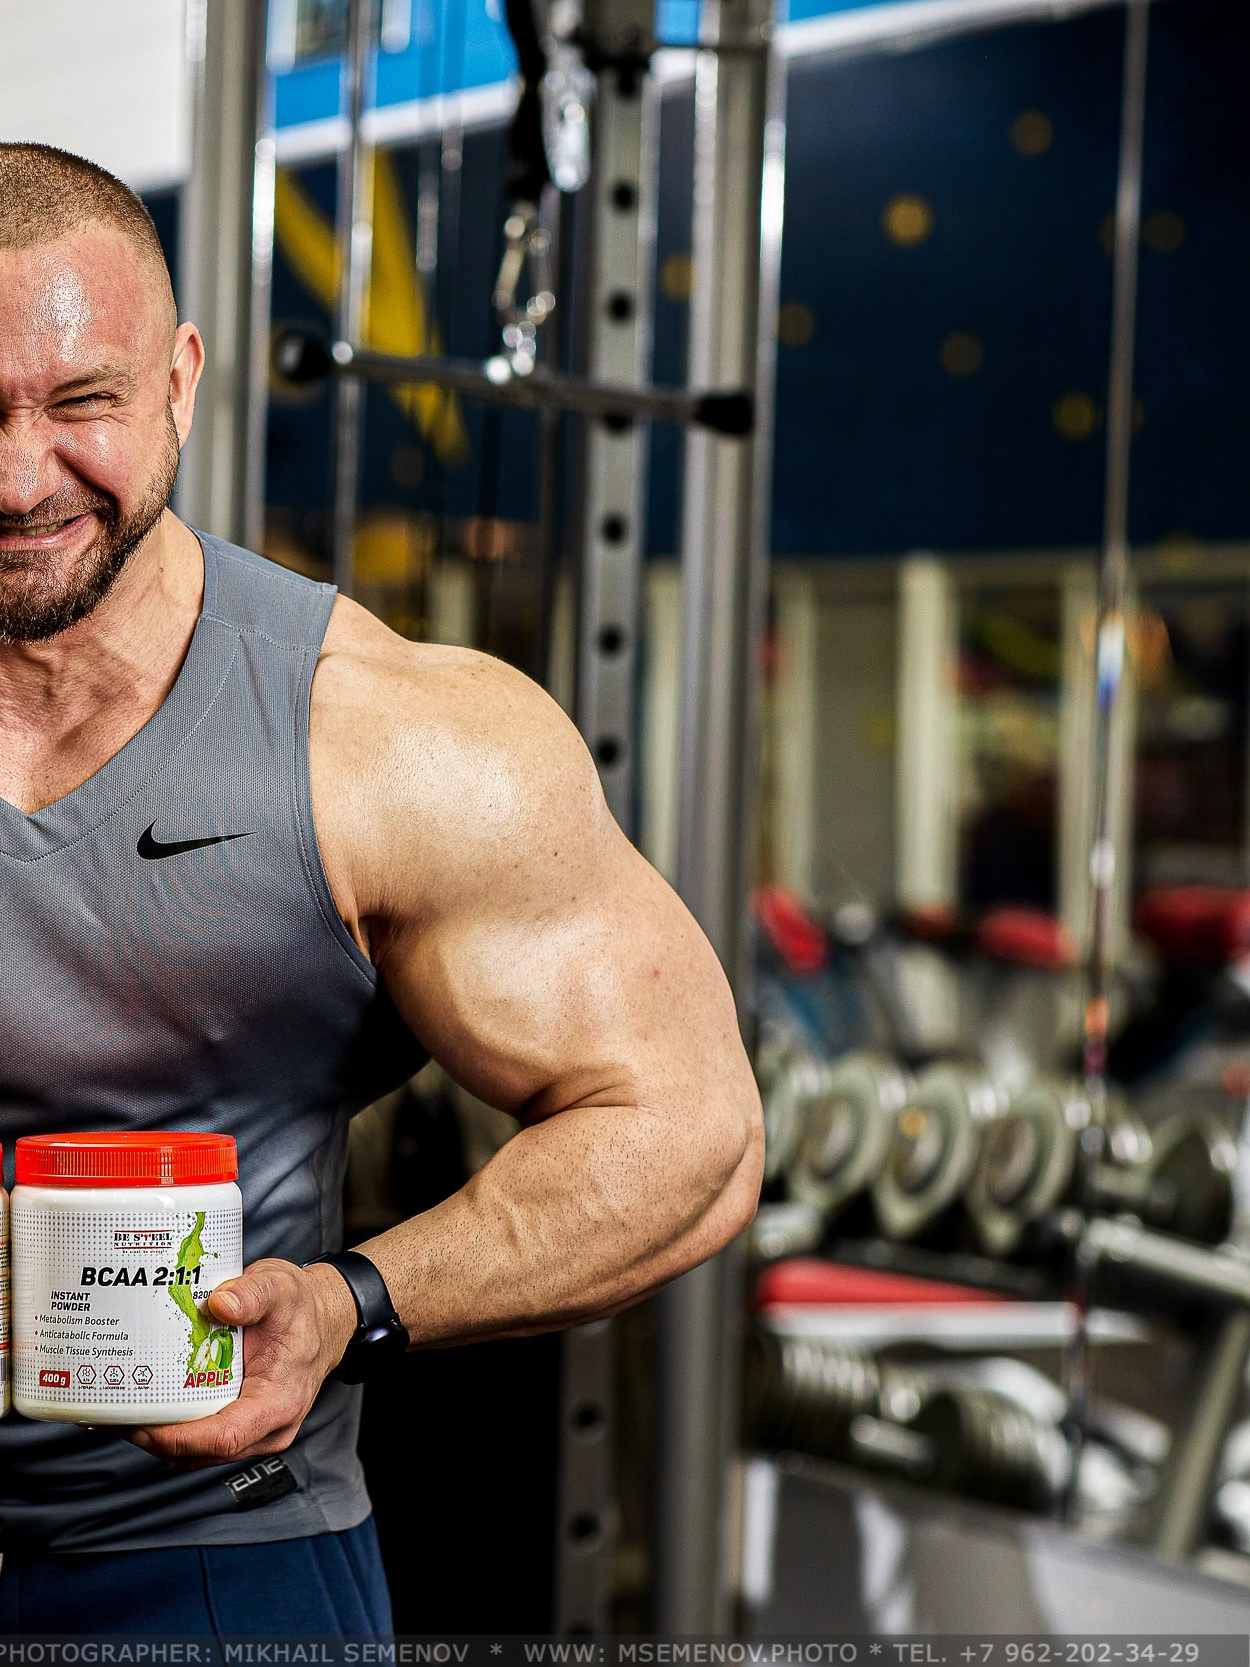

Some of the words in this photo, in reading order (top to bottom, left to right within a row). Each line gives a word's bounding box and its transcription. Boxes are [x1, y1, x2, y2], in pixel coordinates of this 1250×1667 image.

[113, 1232, 130, 1242] BE
[80, 1266, 148, 1287] BCAA
[152, 1265, 201, 1287] 2:1:1
[50, 1290, 91, 1301] INSTANT
[50, 1302, 91, 1312] POWDER
[39, 1313, 84, 1326] Metabolism
[85, 1315, 120, 1326] Booster
[39, 1329, 90, 1341] Anticatabolic
[92, 1330, 129, 1341] Formula
[39, 1343, 64, 1355] Muscle
[65, 1345, 91, 1356] Tissue
[92, 1346, 133, 1358] Synthesis
[183, 1369, 231, 1389] APPLE
